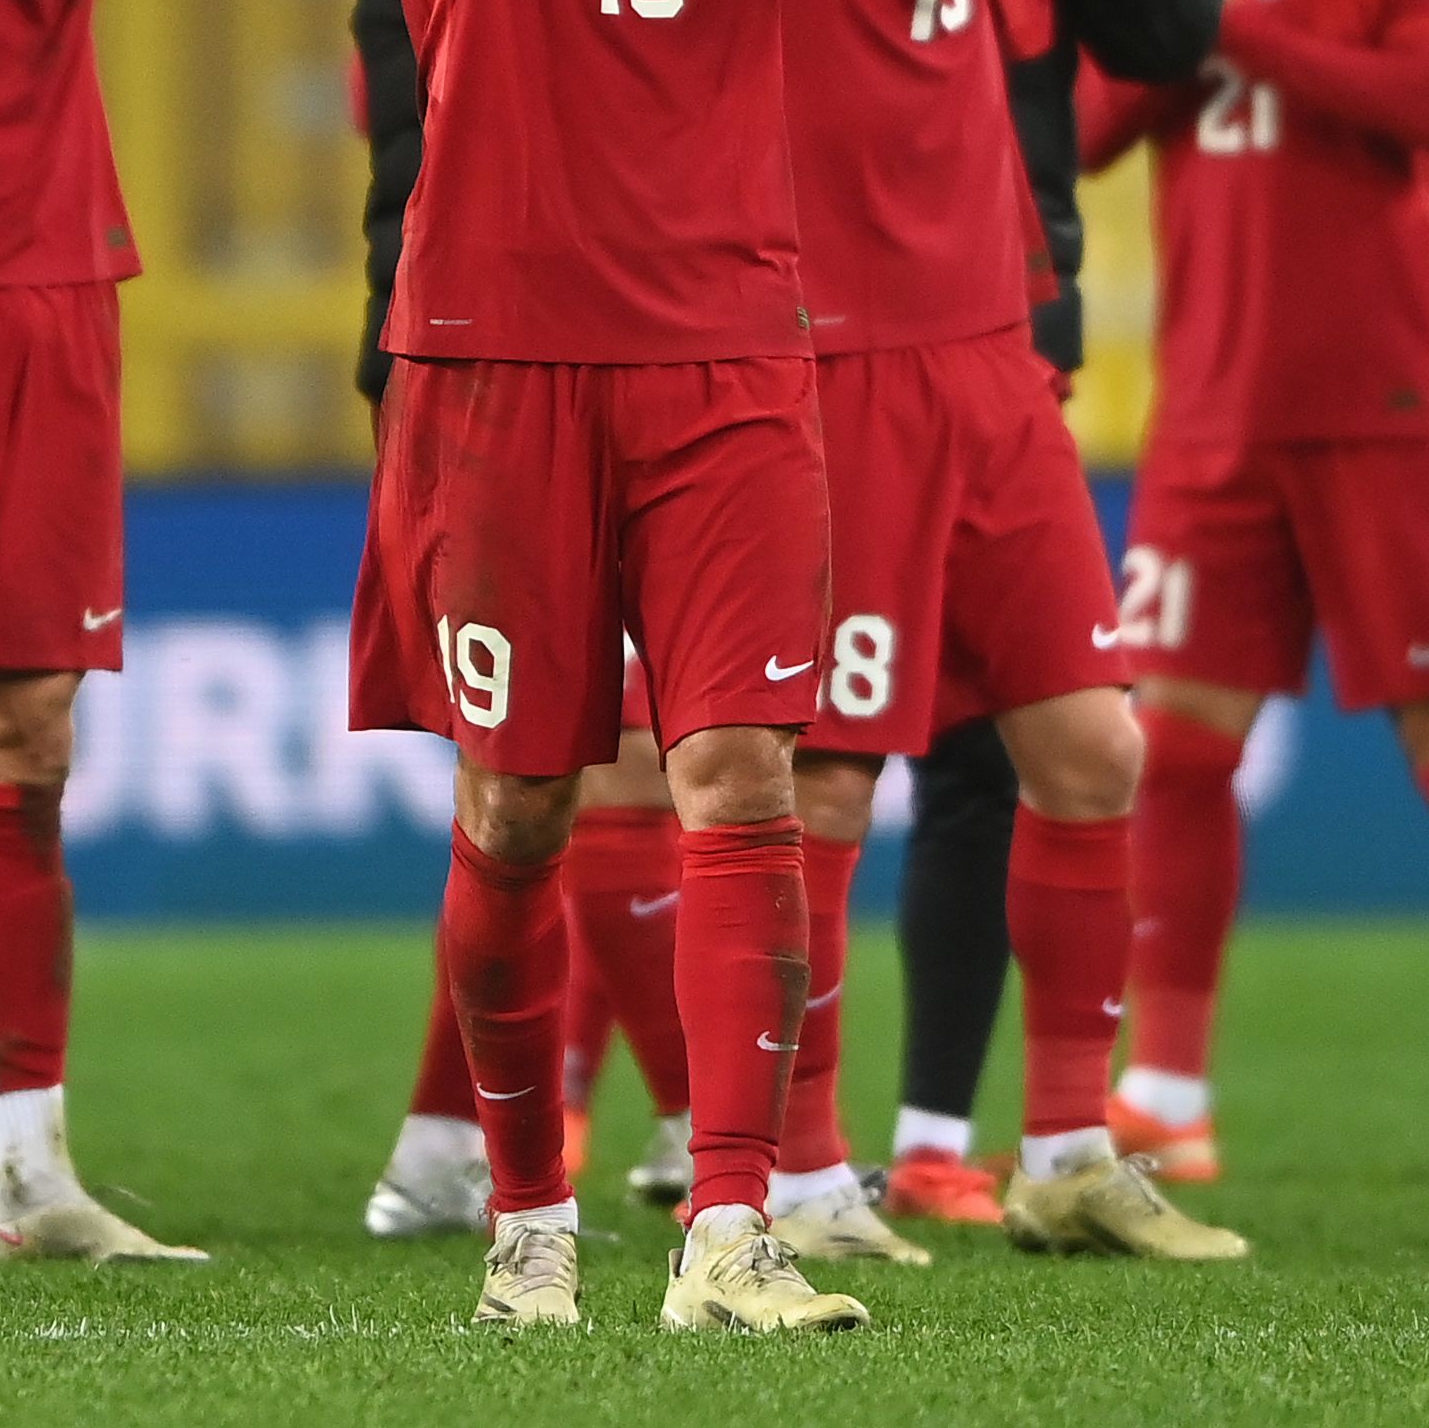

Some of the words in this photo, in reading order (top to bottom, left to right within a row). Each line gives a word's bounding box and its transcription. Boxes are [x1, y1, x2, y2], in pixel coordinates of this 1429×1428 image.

[1196, 57, 1280, 152] 21
[1118, 544, 1192, 649] 21
[437, 614, 511, 729] 19
[817, 614, 893, 716] 8
